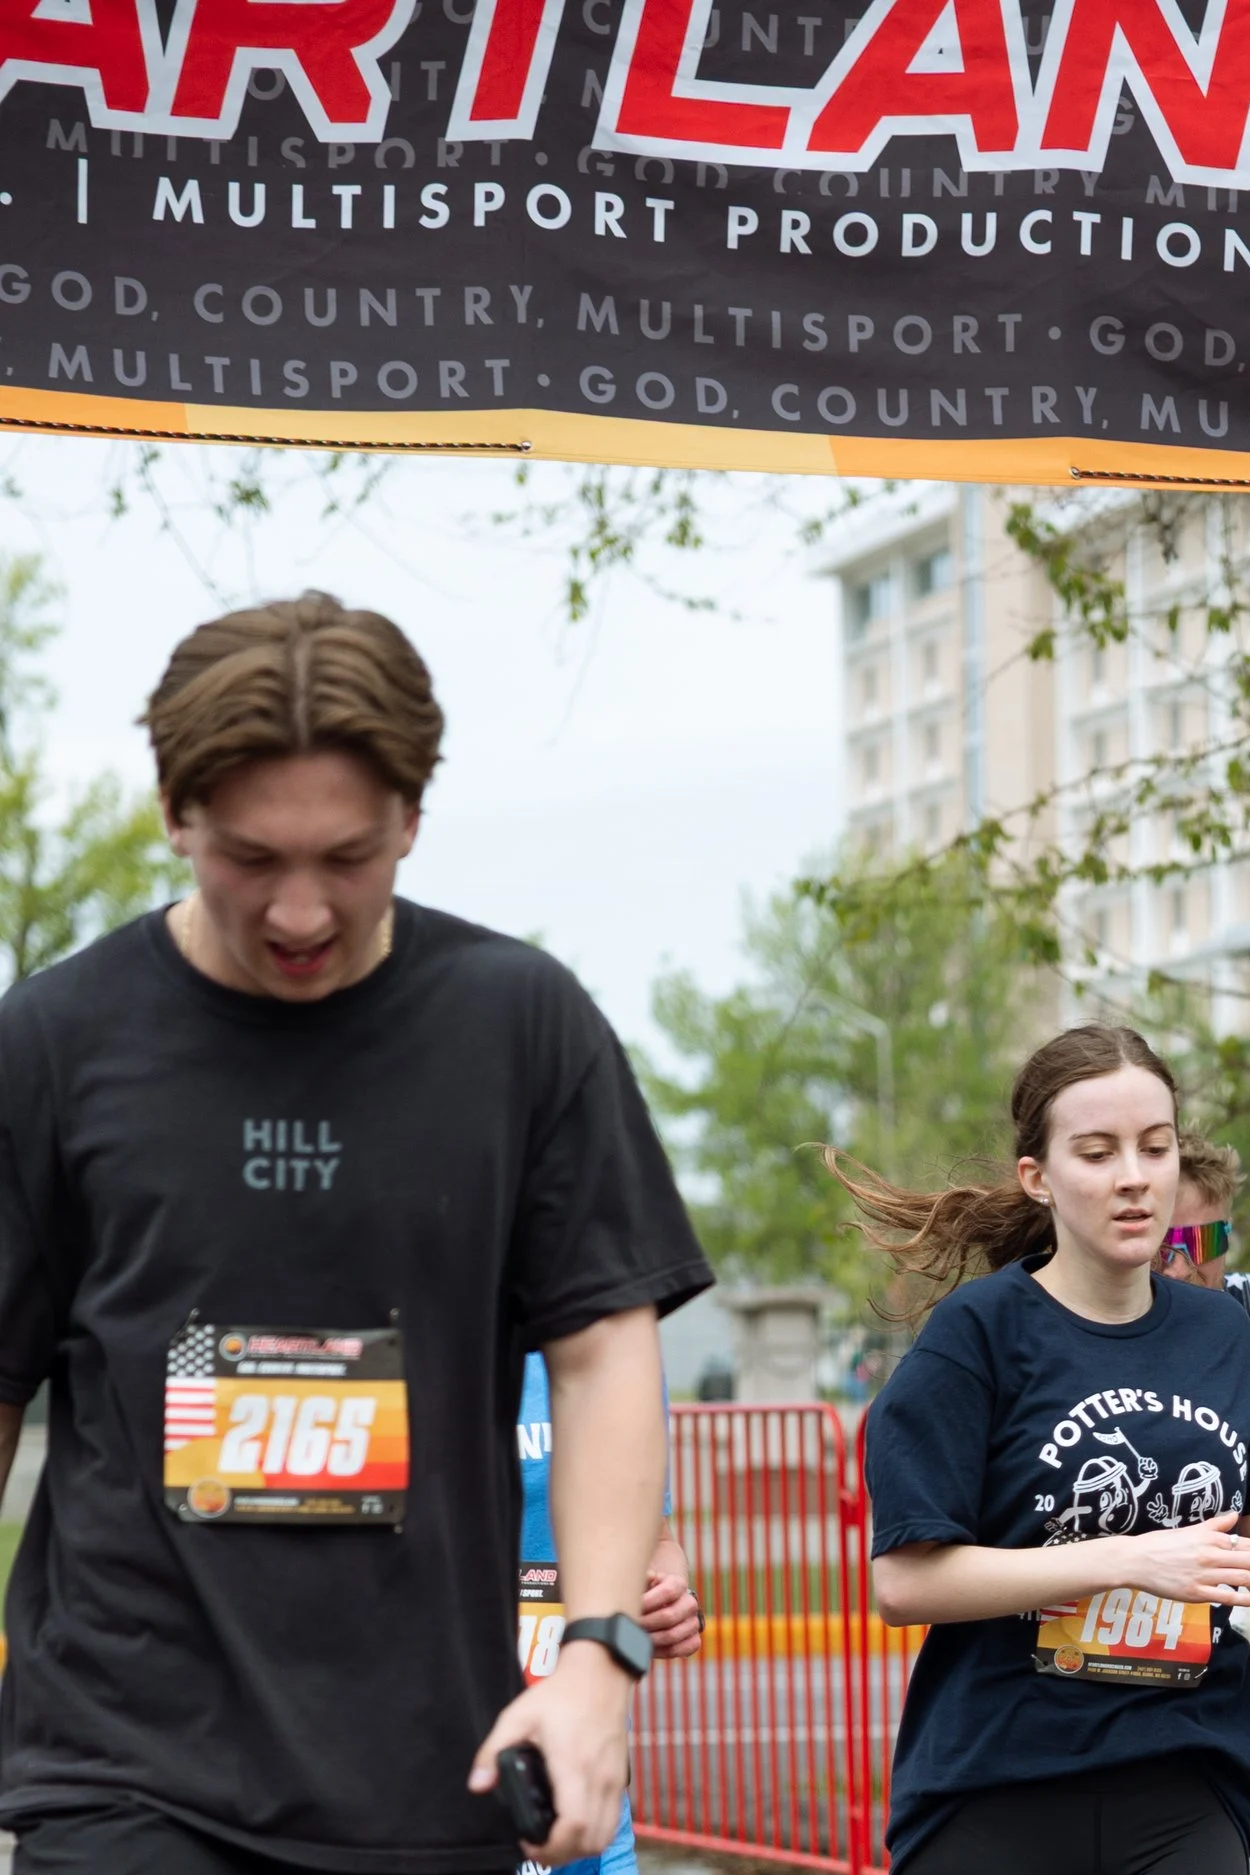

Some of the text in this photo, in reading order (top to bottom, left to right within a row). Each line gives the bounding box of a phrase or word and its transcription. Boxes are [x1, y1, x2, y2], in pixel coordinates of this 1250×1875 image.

[153, 176, 675, 242] MULTISPORT
[194, 283, 545, 328] COUNTRY,
[577, 295, 1023, 355] MULTISPORT
[1090, 315, 1246, 372] GOD,
[49, 343, 511, 399] MULTISPORT
[580, 365, 739, 419] GOD,
[771, 383, 1109, 429] COUNTRY,
[243, 1119, 342, 1152] HILL
[242, 1157, 341, 1191] CITY
[218, 1393, 378, 1477] 2165
[1038, 1388, 1164, 1469] POTTER'S
[1034, 1493, 1056, 1512] 20
[1080, 1587, 1185, 1650] 1984
